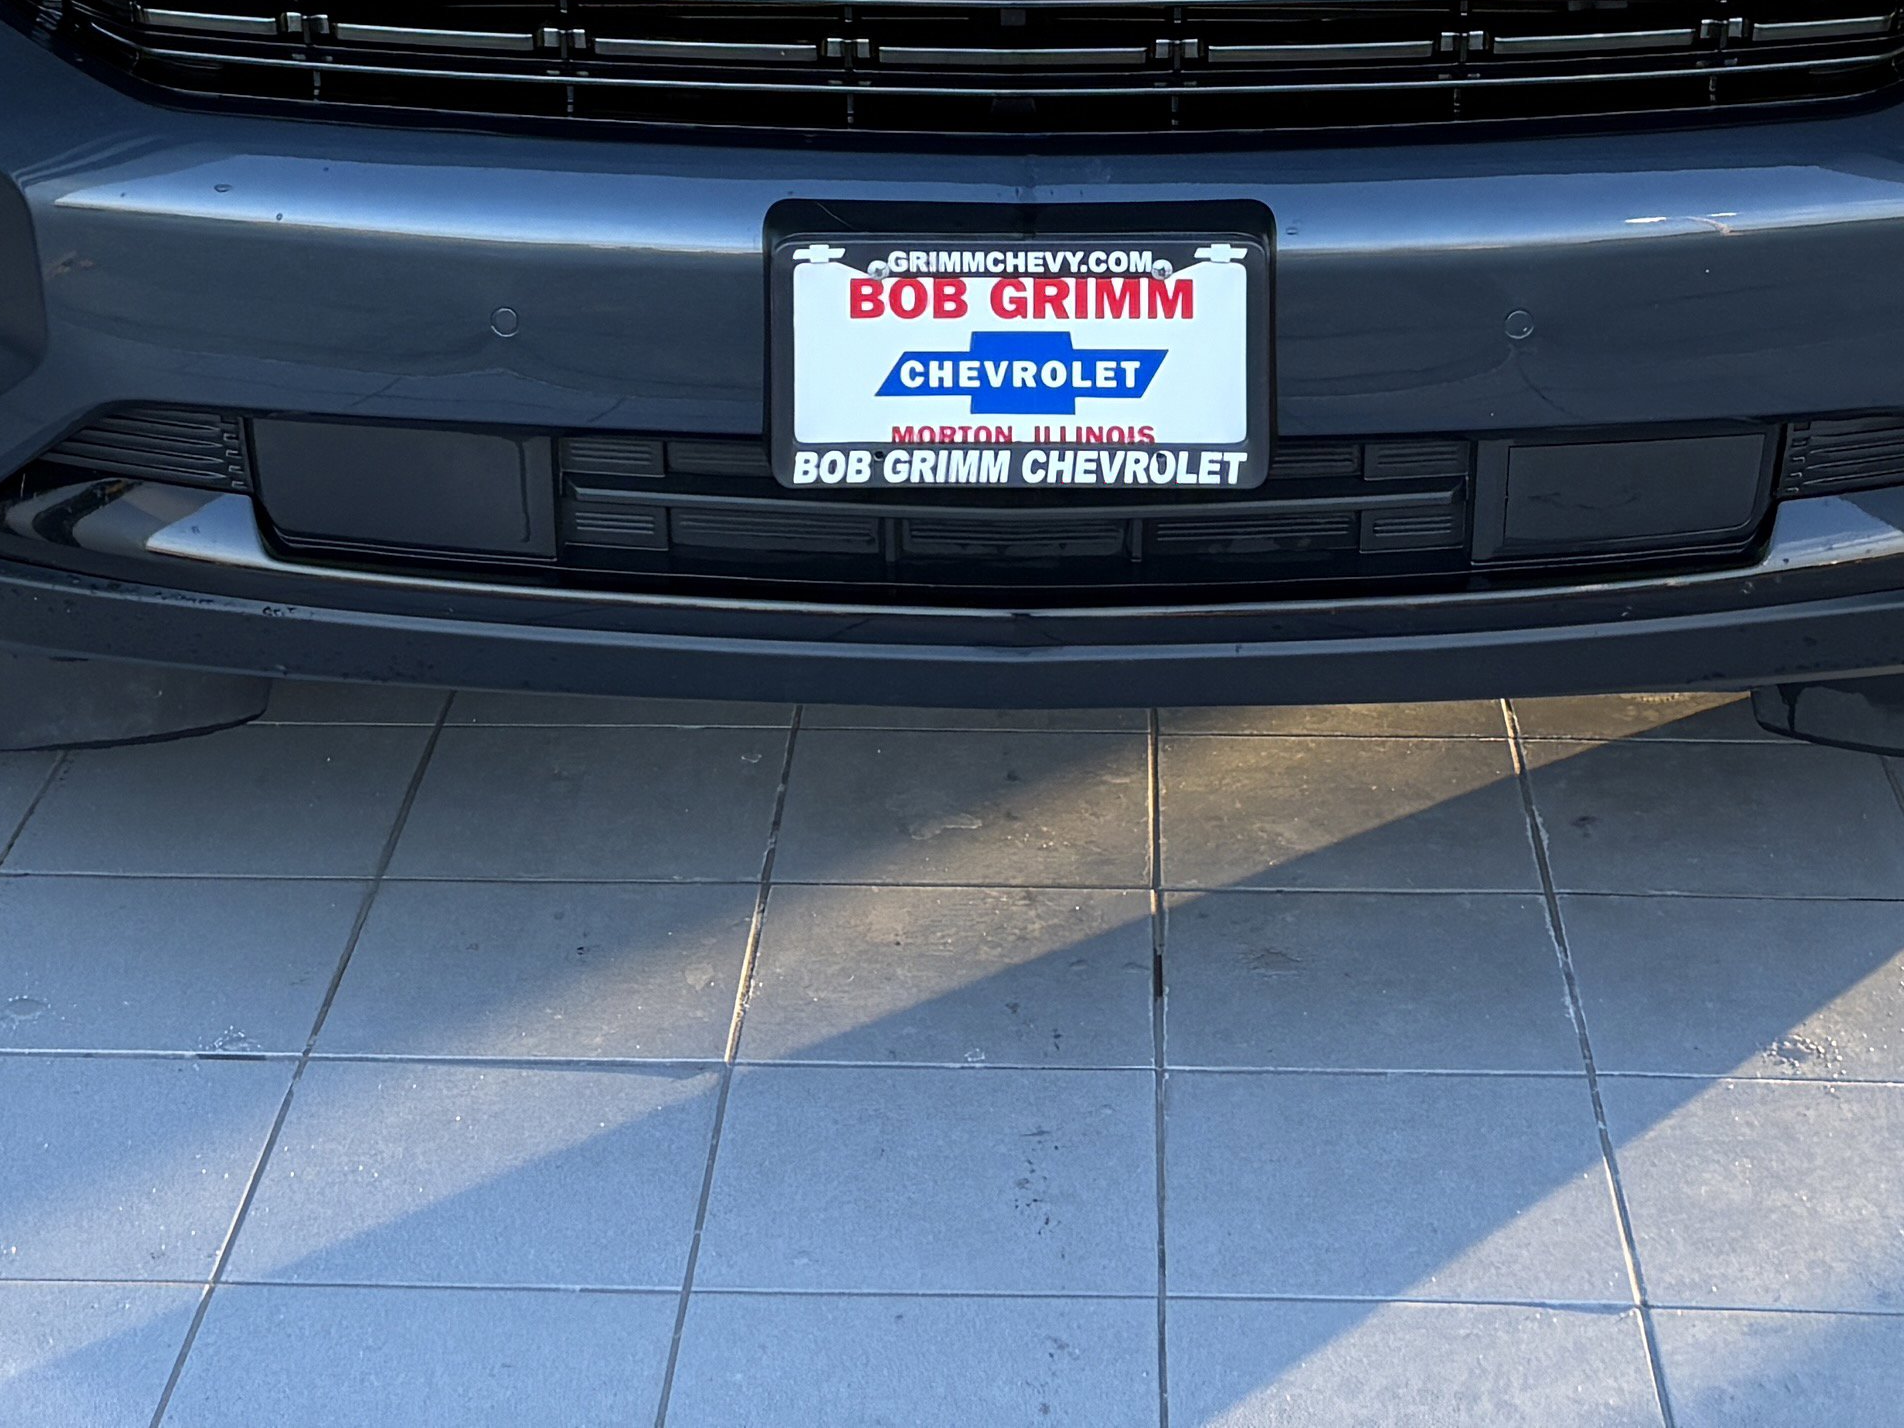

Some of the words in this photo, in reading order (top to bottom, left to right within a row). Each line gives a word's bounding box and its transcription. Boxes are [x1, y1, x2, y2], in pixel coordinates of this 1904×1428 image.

[888, 250, 1153, 274] GRIMMCHEVY.COM
[849, 277, 969, 320] BOB
[990, 277, 1194, 320] GRIMM
[899, 359, 1141, 388] CHEVROLET
[891, 424, 1013, 444] MORTON
[1034, 424, 1155, 444] ILLINOIS
[794, 450, 872, 485] BOB
[883, 450, 1011, 485] GRIMM
[1022, 450, 1248, 485] CHEVROLET
